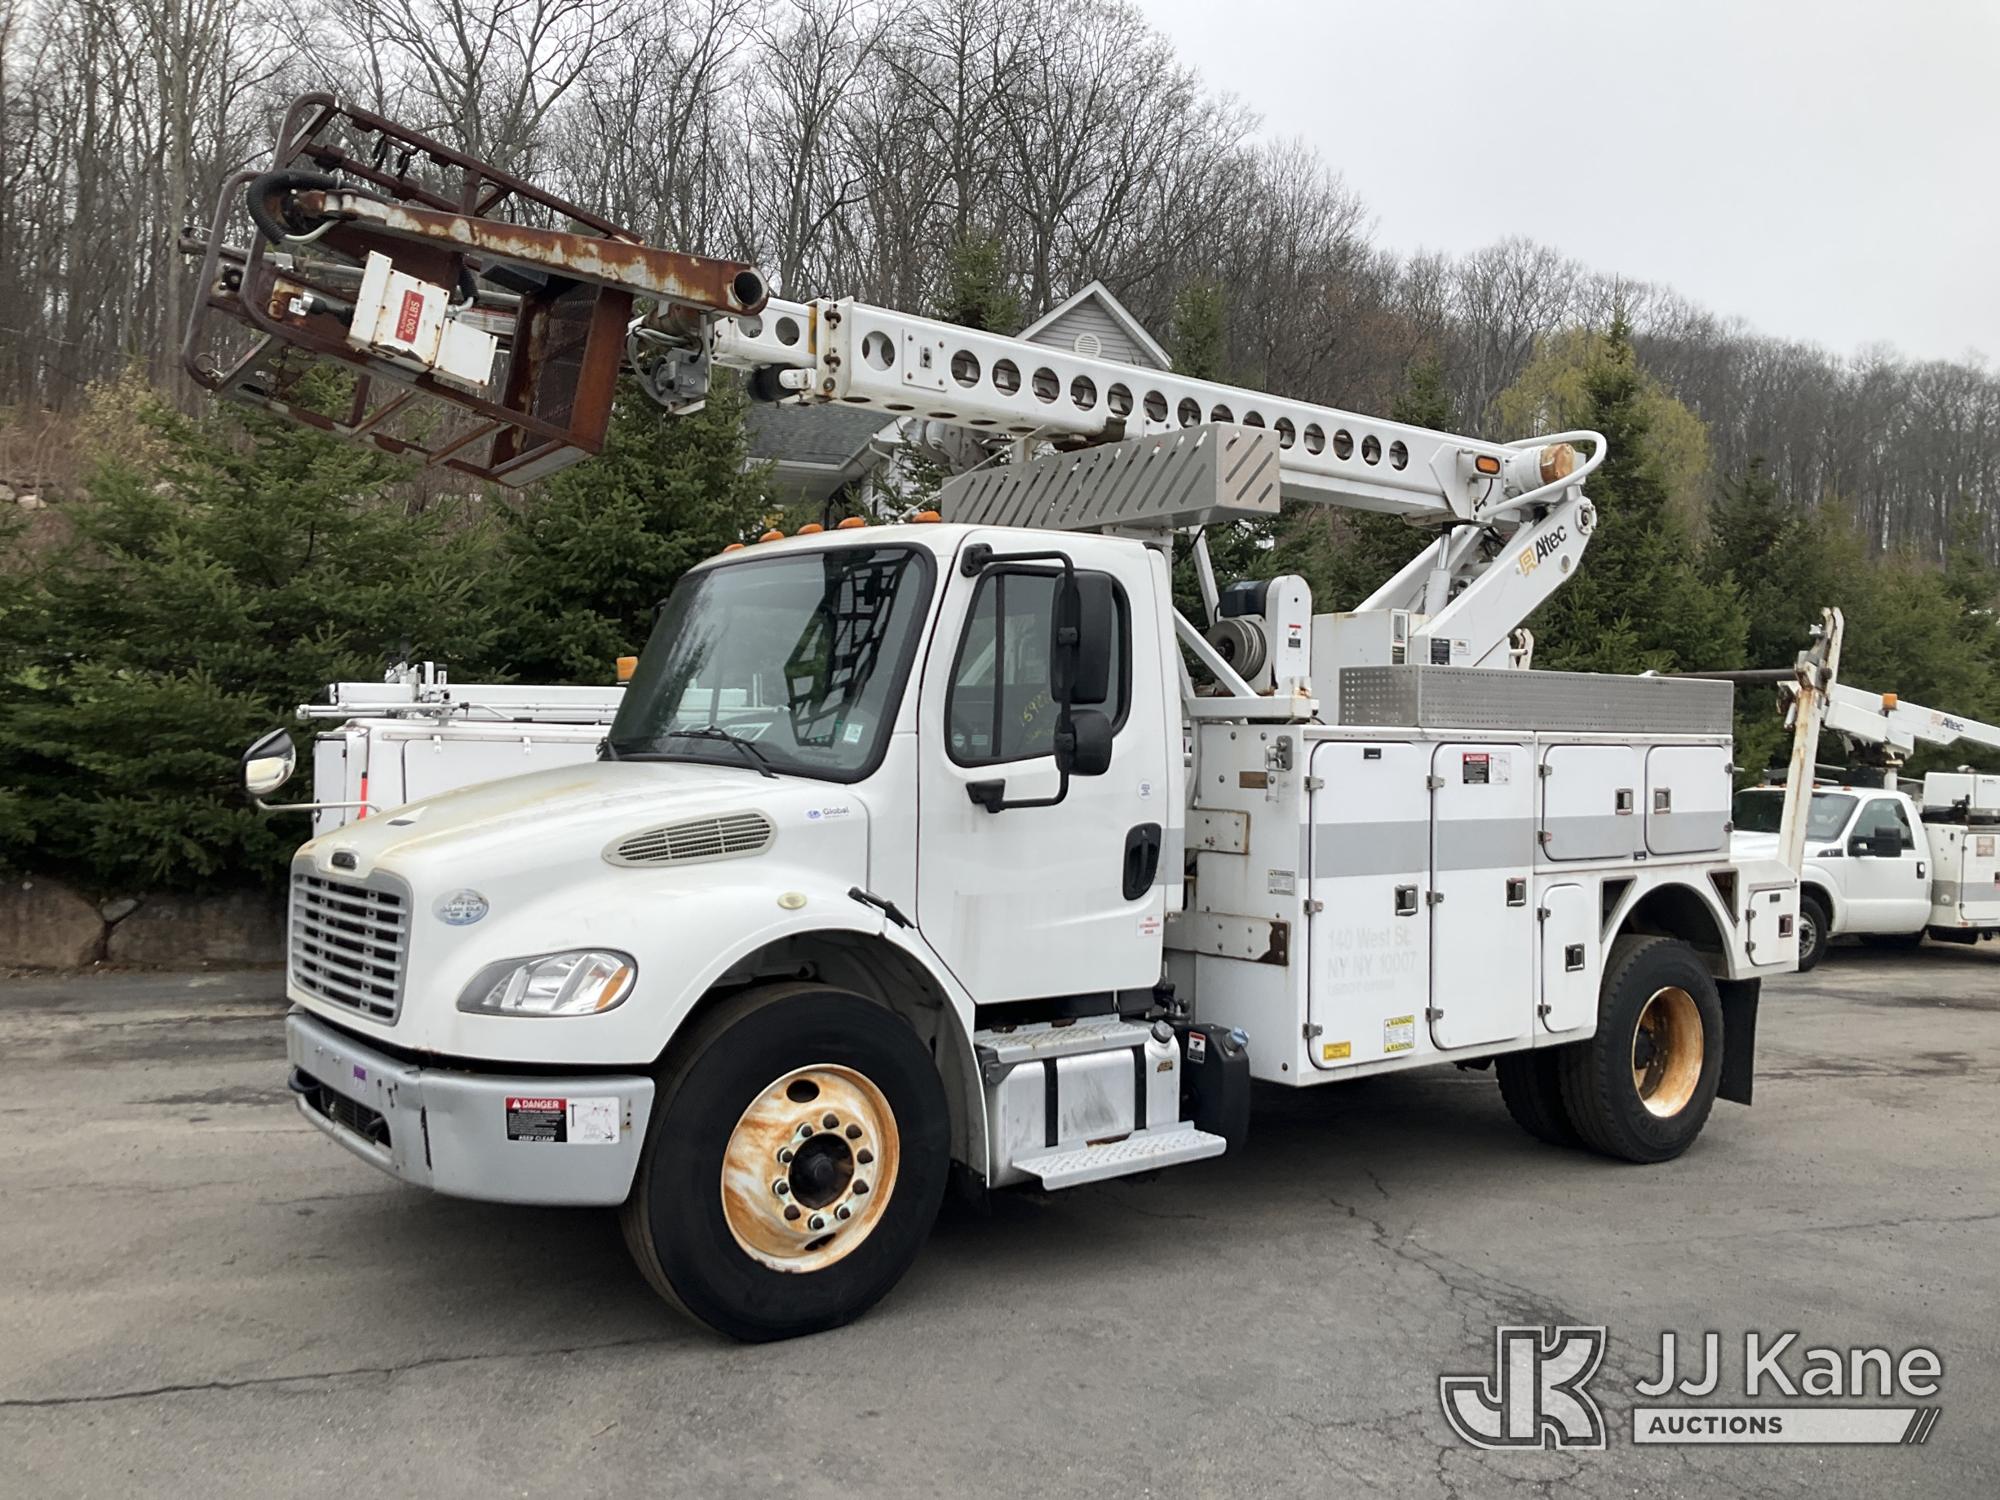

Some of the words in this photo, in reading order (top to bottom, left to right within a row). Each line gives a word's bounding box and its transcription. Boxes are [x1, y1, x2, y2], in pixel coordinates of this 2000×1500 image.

[408, 300, 420, 318] LBS
[405, 318, 416, 335] 500
[1535, 525, 1567, 564] Altec
[1941, 717, 1965, 732] Altec
[822, 806, 850, 816] Global
[1327, 928, 1353, 951] 140
[1356, 927, 1391, 950] West
[1327, 956, 1349, 979] NY
[1352, 954, 1373, 977] NY
[1379, 950, 1418, 974] 10007
[522, 1099, 560, 1109] DANGER
